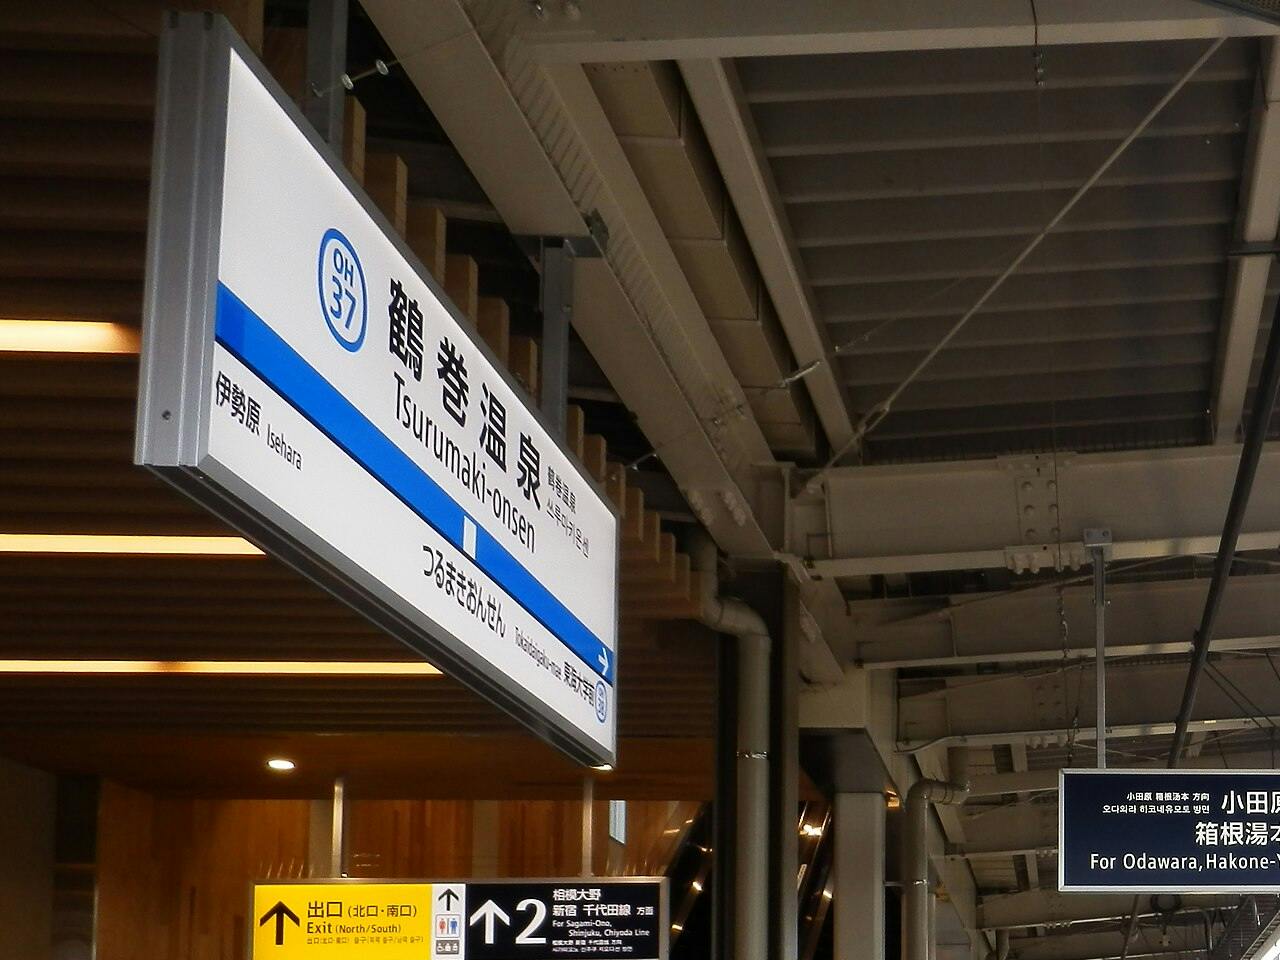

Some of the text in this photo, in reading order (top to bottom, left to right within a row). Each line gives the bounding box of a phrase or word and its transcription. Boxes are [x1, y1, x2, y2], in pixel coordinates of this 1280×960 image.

[333, 248, 354, 287] OH
[330, 275, 356, 329] 37
[388, 277, 541, 511] 鶴巻温泉
[215, 370, 302, 471] 伊勢原 Isehara
[393, 371, 536, 554] Tsurumaki-onsen
[422, 545, 506, 637] つるまきおんせん
[1090, 853, 1116, 870] For
[552, 889, 602, 901] 相模大野
[307, 901, 343, 919] 出口
[515, 899, 547, 945] 2
[552, 904, 654, 917] 新宿 千代田線 方面
[306, 921, 402, 935] Exit (North/South)
[566, 920, 612, 929] Sagami-Ono,
[604, 929, 633, 938] Chiyoda
